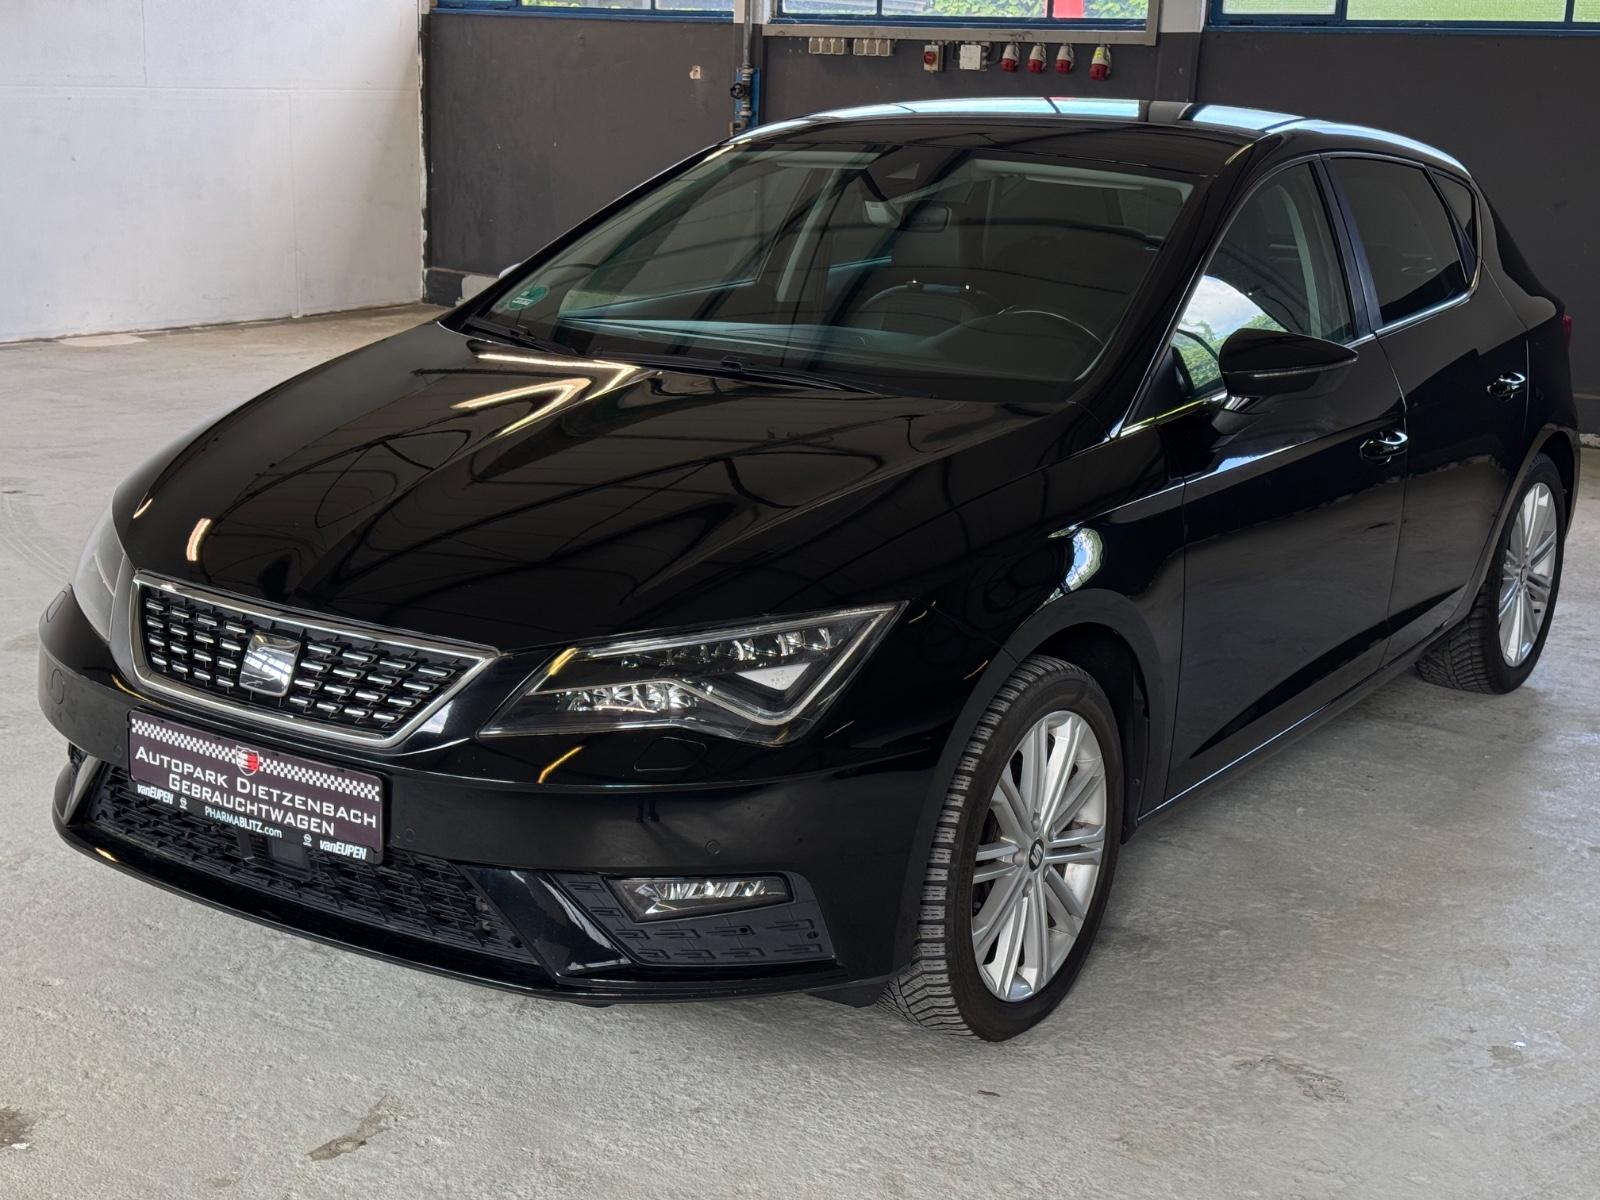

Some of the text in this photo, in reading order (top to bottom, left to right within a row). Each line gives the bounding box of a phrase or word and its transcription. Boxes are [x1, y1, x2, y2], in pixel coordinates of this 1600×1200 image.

[135, 746, 377, 828] AUTOPARK DIETZENBACH
[137, 784, 173, 804] vanEUPEN
[168, 773, 335, 836] GEBRAUCHTWAGEN
[204, 806, 282, 838] PHARMABLITZ.com
[319, 839, 367, 860] vanEUPEN
